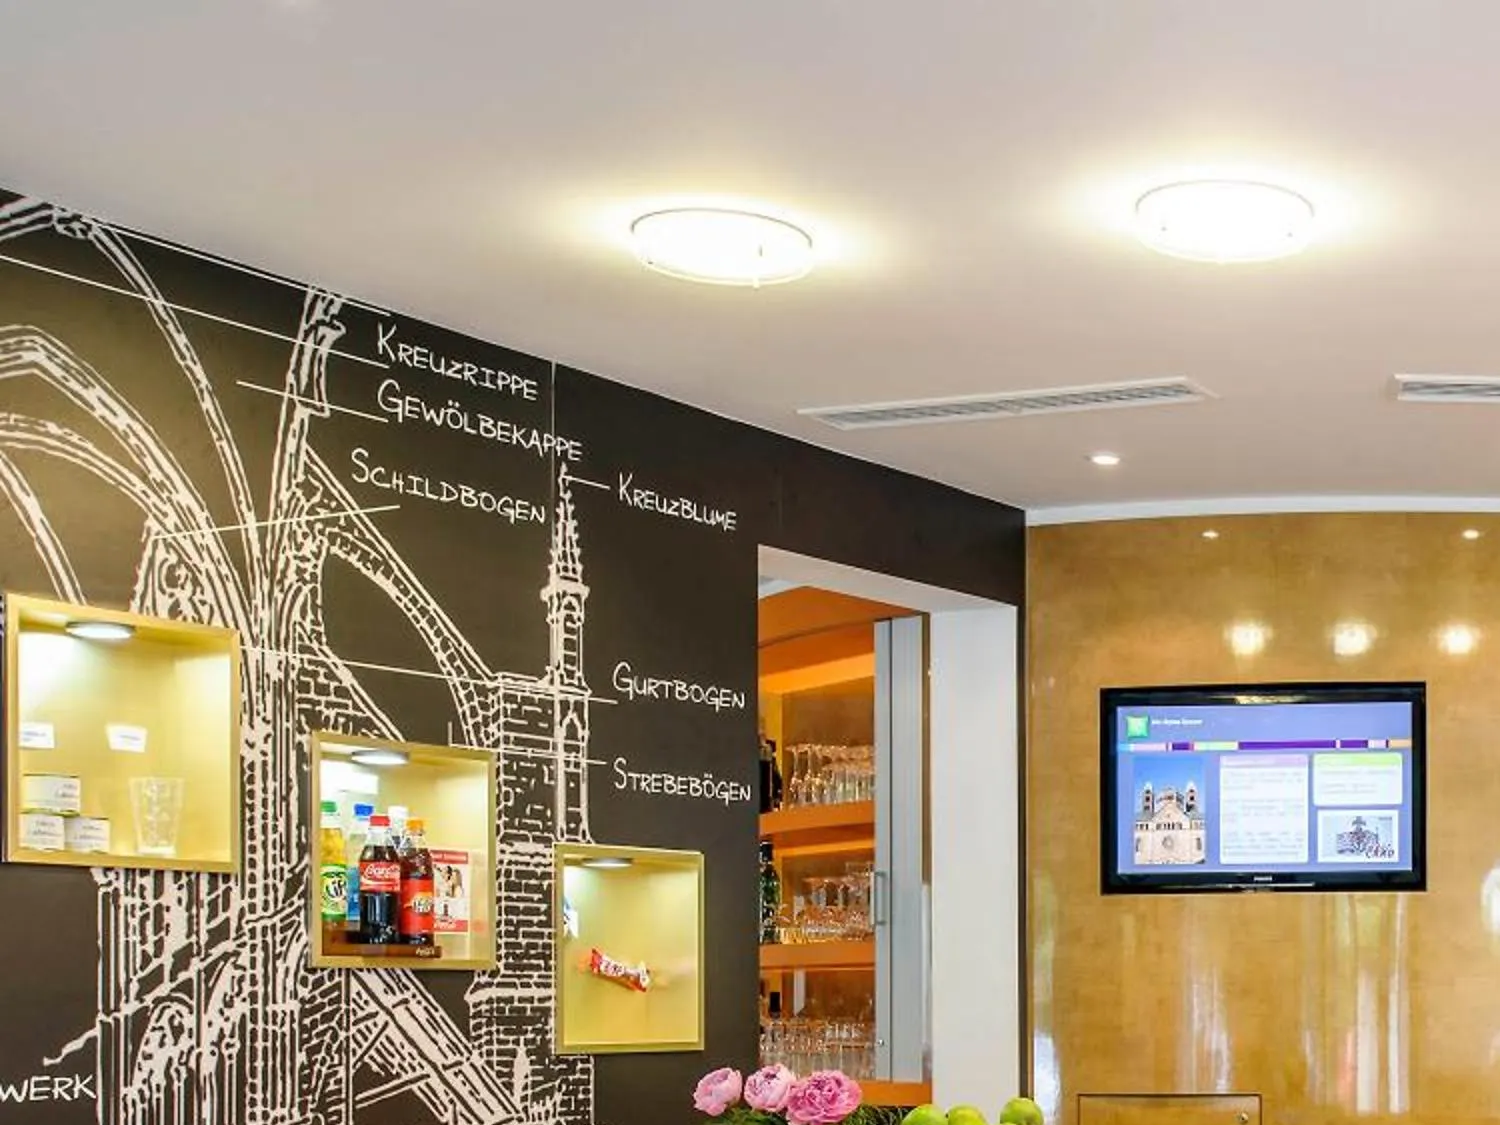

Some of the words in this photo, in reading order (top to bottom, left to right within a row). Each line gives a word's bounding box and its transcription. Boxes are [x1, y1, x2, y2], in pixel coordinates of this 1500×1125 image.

[377, 325, 538, 401] KREUZRIPPE
[377, 379, 583, 461] GEWÖLBEKAPPE
[350, 448, 546, 525] SCHILDBOGEN
[619, 473, 737, 530] KREUZBLUME
[612, 661, 746, 710] GURTBOGEN
[613, 758, 752, 802] STREBEBÖGEN
